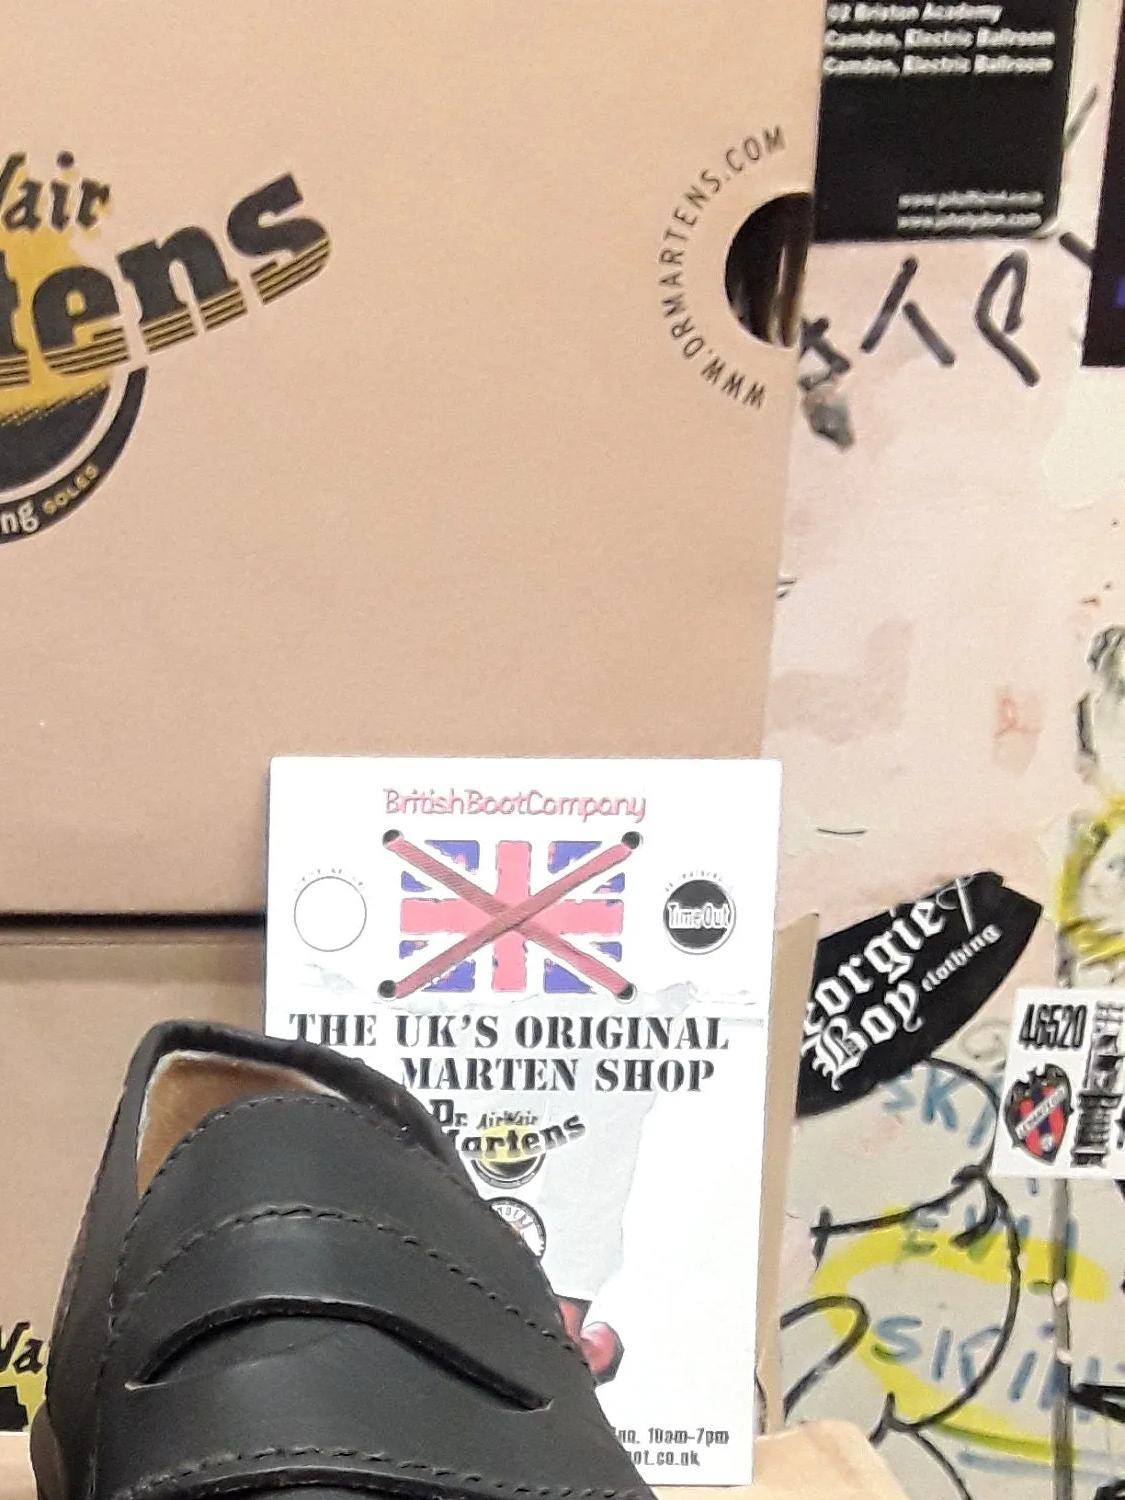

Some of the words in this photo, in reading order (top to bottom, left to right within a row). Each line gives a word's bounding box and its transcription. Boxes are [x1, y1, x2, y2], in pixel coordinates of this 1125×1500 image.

[854, 4, 919, 22] Brixton
[921, 3, 1003, 25] Academy
[904, 28, 974, 48] Electric
[977, 27, 1055, 47] Ballroom
[902, 54, 972, 75] Electric
[974, 54, 1054, 75] Ballroom
[658, 125, 787, 410] WWW.DRMARTENS.COM
[383, 788, 646, 823] BritishBootCompany
[288, 1012, 378, 1048] THE
[395, 1014, 500, 1050] UK'S
[514, 1013, 730, 1051] ORIGINAL
[800, 979, 924, 1092] Boy
[400, 1056, 581, 1093] MARTEN
[594, 1058, 716, 1094] SHOP
